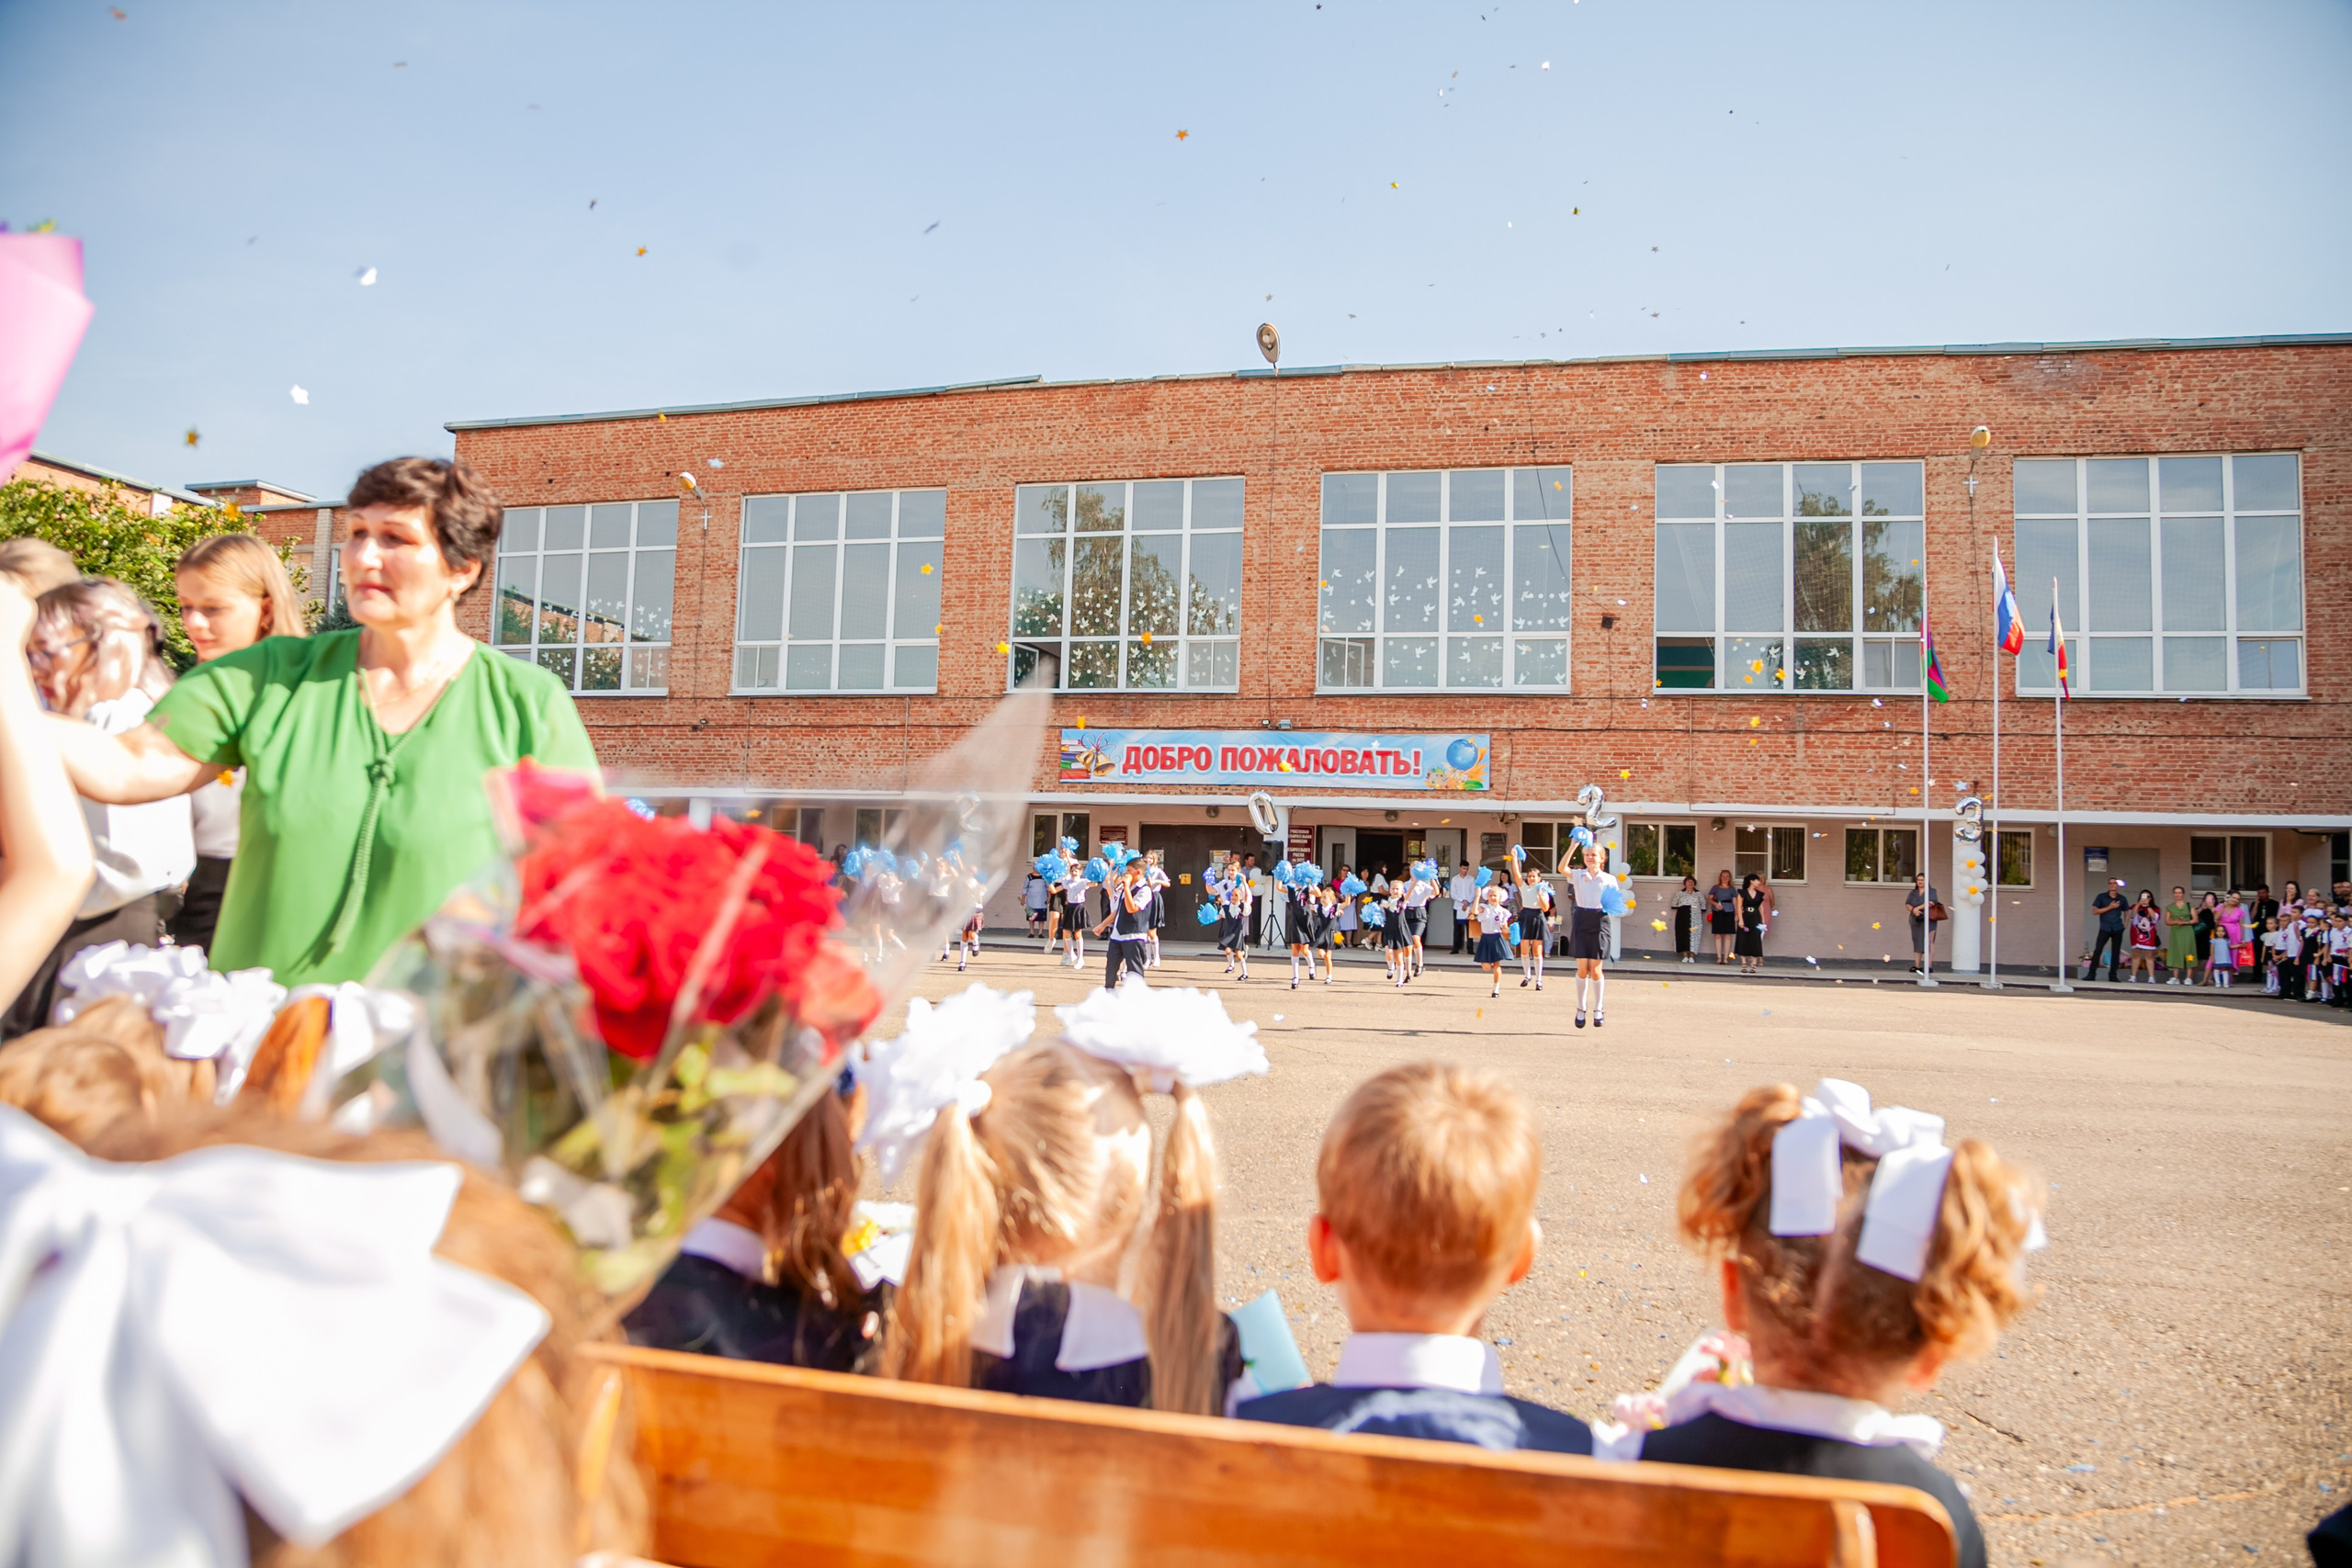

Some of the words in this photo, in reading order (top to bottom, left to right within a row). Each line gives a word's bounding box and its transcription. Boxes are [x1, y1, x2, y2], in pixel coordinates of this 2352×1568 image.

[1122, 746, 1212, 774] ДОБРО
[1220, 747, 1420, 775] ПОЖАЛОВАТЬ!
[1248, 791, 1279, 835] 0
[1577, 784, 1617, 832] 2
[1955, 796, 1984, 842] 3
